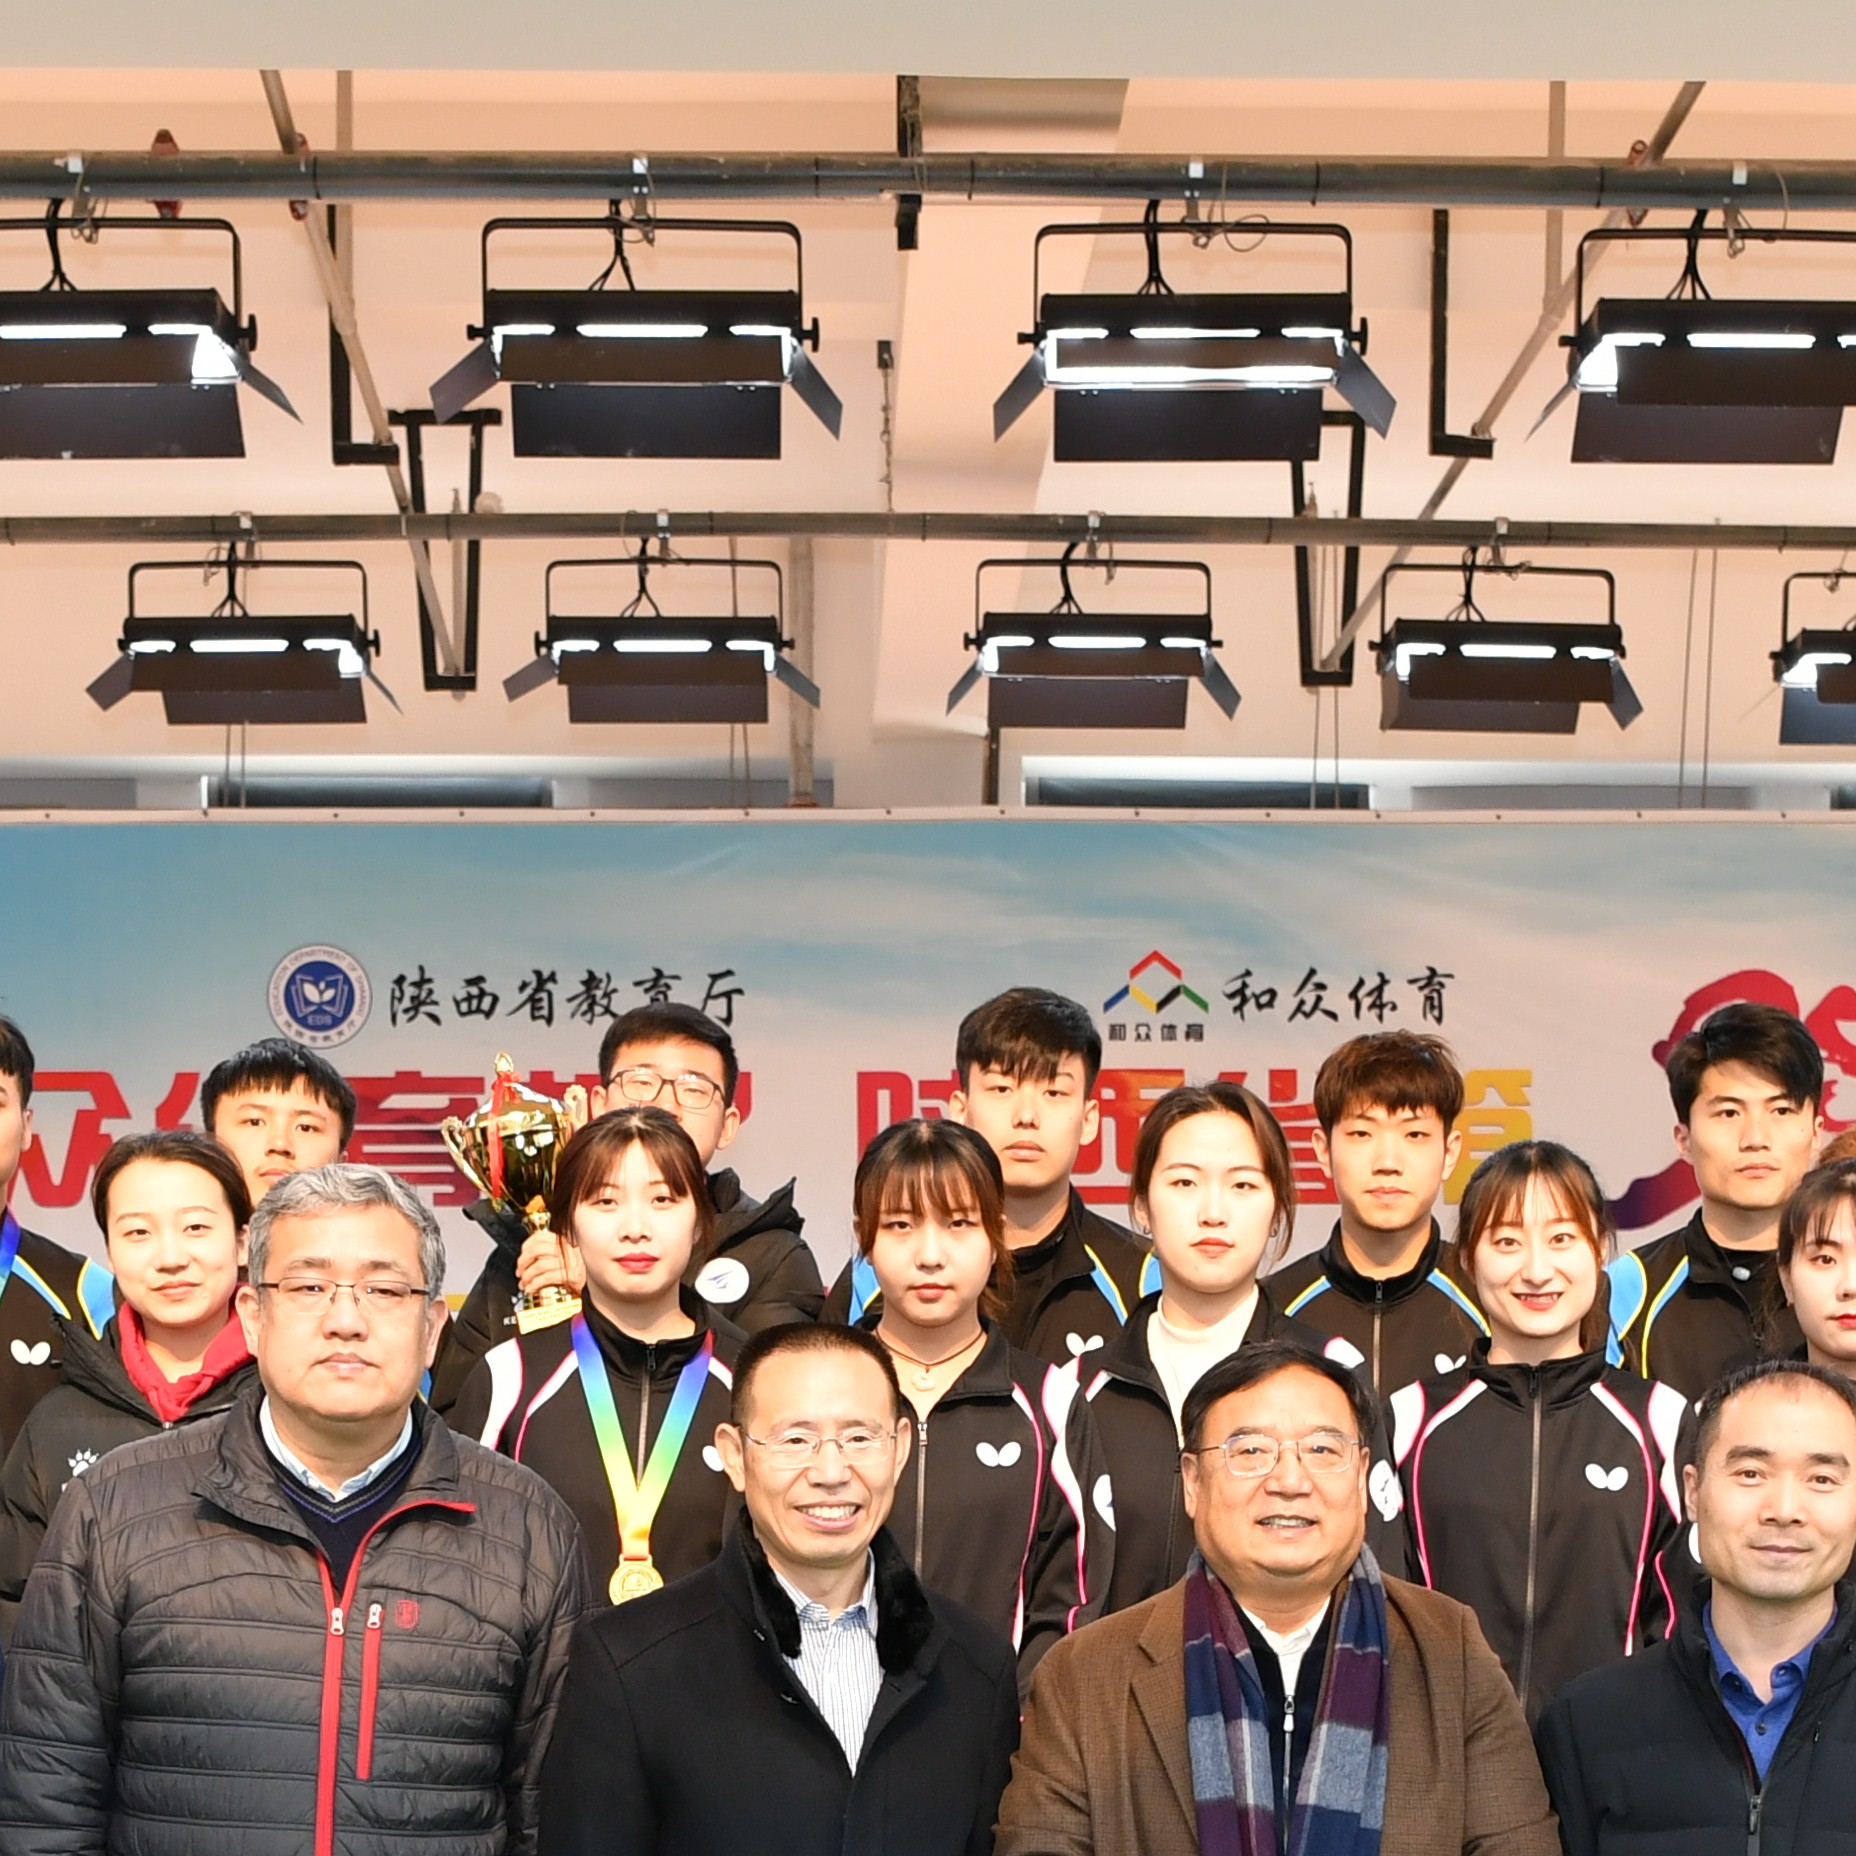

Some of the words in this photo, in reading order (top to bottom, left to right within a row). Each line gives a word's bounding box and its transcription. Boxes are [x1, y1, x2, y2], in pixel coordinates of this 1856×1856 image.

[389, 965, 745, 1027] 陕西省教育厅
[1222, 966, 1455, 1026] 和众体育
